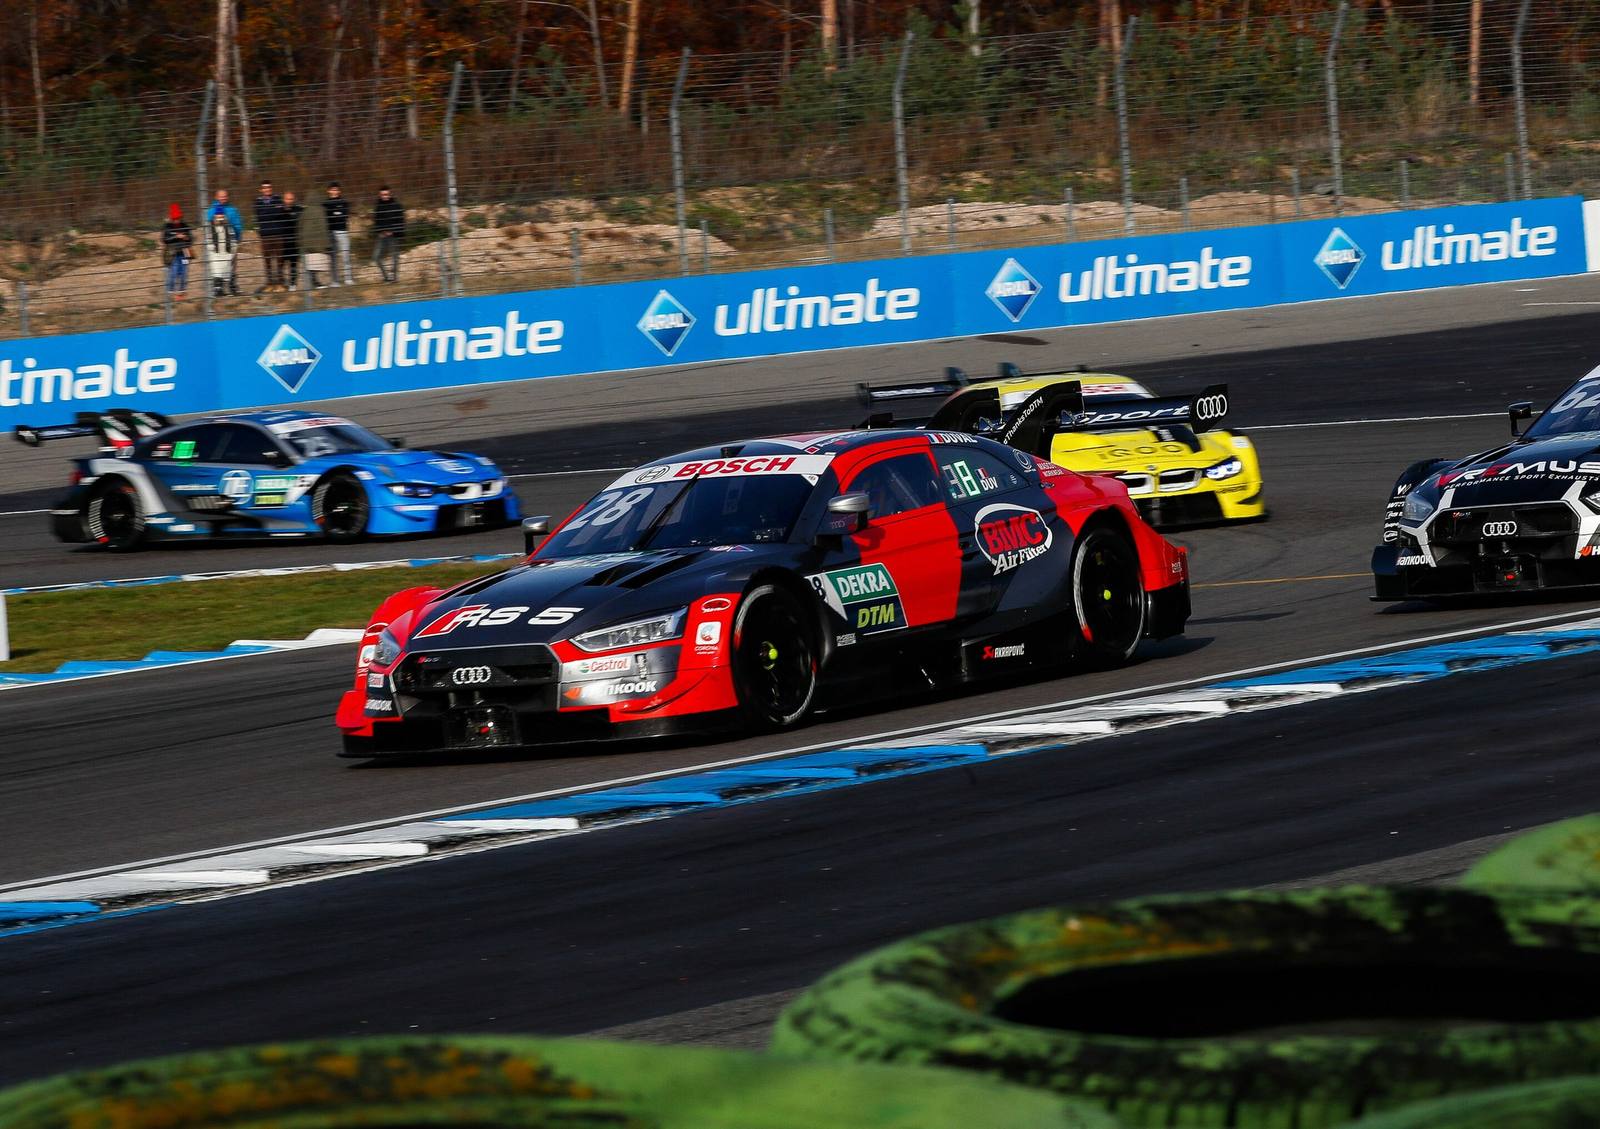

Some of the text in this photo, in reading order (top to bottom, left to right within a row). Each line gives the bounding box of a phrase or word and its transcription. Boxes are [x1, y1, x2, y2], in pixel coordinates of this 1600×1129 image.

[1381, 217, 1557, 270] ultimate
[1059, 246, 1252, 303] ultimate
[714, 278, 920, 336] ultimate
[342, 310, 564, 372] ultimate
[941, 432, 978, 444] DUVAL
[673, 456, 797, 478] BOSCH
[980, 477, 998, 491] DUV
[1443, 475, 1511, 490] PERFORMANCE
[559, 487, 655, 533] 28
[980, 512, 1043, 555] BMC
[993, 544, 1047, 576] Air Filter
[836, 570, 891, 598] DEKRA
[527, 607, 585, 625] 5
[857, 603, 895, 628] DTM
[591, 658, 629, 672] Castrol
